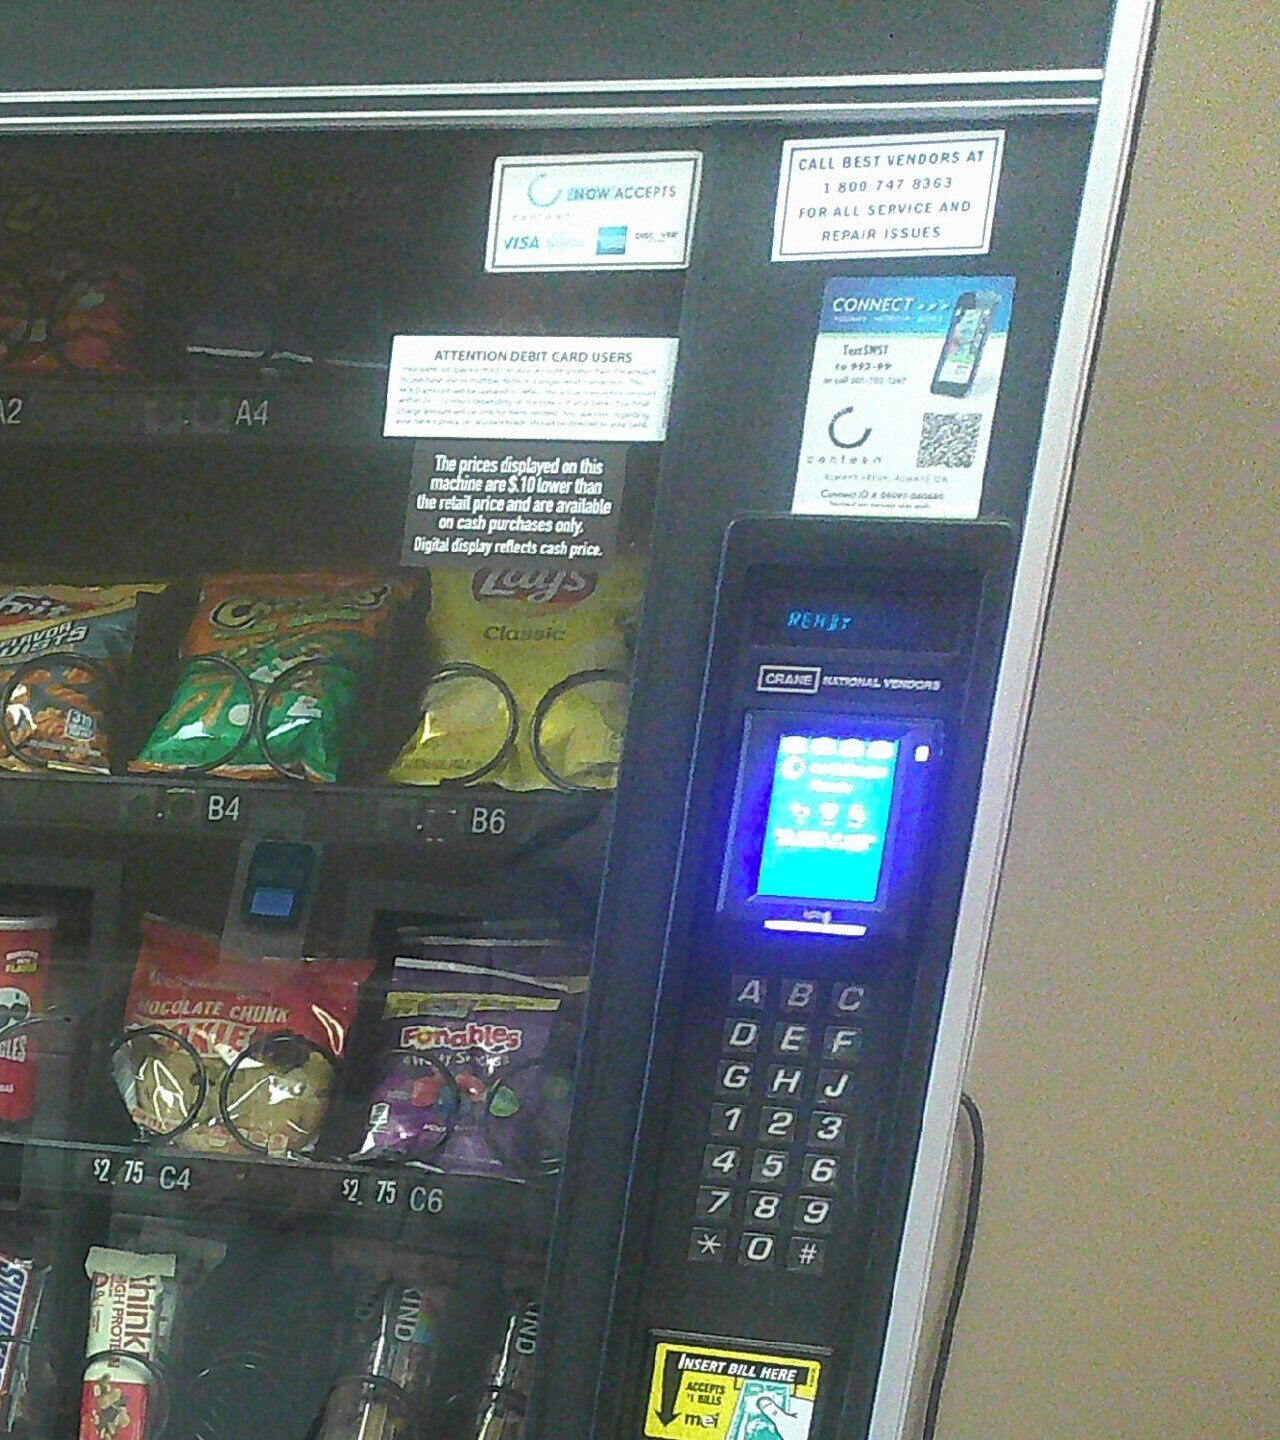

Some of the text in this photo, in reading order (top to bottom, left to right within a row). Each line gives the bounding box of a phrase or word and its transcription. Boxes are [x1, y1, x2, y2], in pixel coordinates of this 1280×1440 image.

[799, 150, 984, 170] CALL BEST VENDORS AT
[575, 186, 676, 200] NOW ACCEPTS
[824, 177, 952, 193] 1 800 747 8363
[799, 201, 970, 219] FOR ALL SERVICE AND
[504, 236, 539, 250] VISA
[822, 227, 940, 241] REPAIR ISSUES
[833, 297, 914, 312] CONNECT
[434, 350, 632, 364] ATTENTION DEBIT CARD USERS
[235, 400, 269, 427] A4
[435, 455, 603, 476] The prices displayed on this
[430, 475, 482, 492] machine
[485, 479, 510, 493] are
[537, 476, 572, 494] lower
[575, 479, 602, 495] than
[417, 495, 612, 515] the retail price and are available
[438, 517, 453, 530] on
[457, 515, 486, 530] cash
[487, 518, 552, 535] purchases
[414, 536, 603, 558] Digital display reflects cash price.
[483, 625, 566, 642] Classic
[765, 672, 941, 691] CRANE NATIONAL VENDORS
[207, 795, 506, 835] B4 B6
[738, 979, 865, 1010] A B C
[229, 1005, 290, 1023] CHUNK
[730, 1023, 857, 1053] D E F
[723, 1064, 849, 1098] G H J
[725, 1108, 843, 1140] 1 2 3
[712, 1150, 836, 1183] 4 5 6
[159, 1164, 192, 1191] C4
[409, 1185, 443, 1213] C6
[707, 1190, 829, 1224] 7 8 9
[747, 1236, 774, 1261] 0
[678, 1353, 798, 1382] INSERT BILL HERE
[685, 1381, 726, 1395] ACCEPTS
[698, 1394, 722, 1406] BILLS
[685, 1413, 719, 1429] mei
